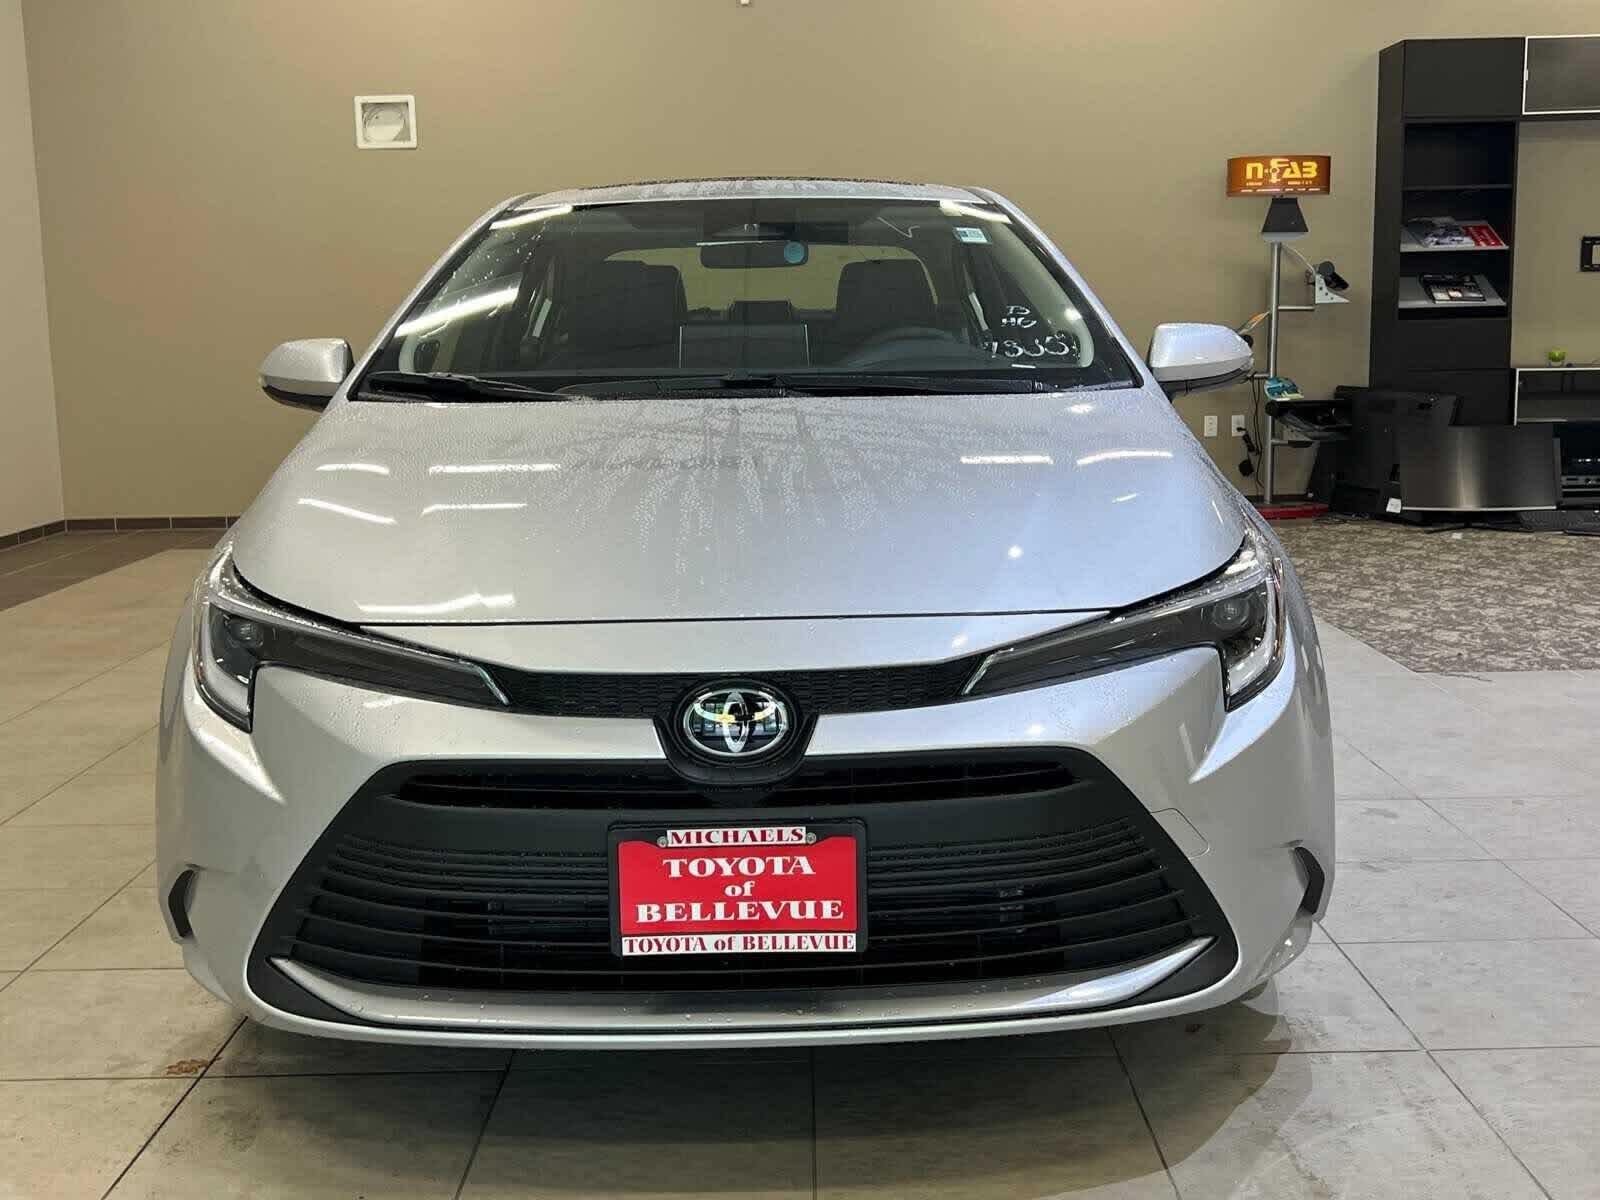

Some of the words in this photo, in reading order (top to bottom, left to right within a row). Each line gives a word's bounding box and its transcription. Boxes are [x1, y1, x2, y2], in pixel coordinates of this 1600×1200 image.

[670, 828, 804, 844] MICHAELS
[662, 856, 816, 878] TOYOTA
[724, 881, 756, 897] of
[635, 900, 844, 923] BELLEVUE
[624, 937, 707, 953] TOYOTA
[714, 936, 736, 951] of
[743, 935, 855, 951] BELLEVUE
